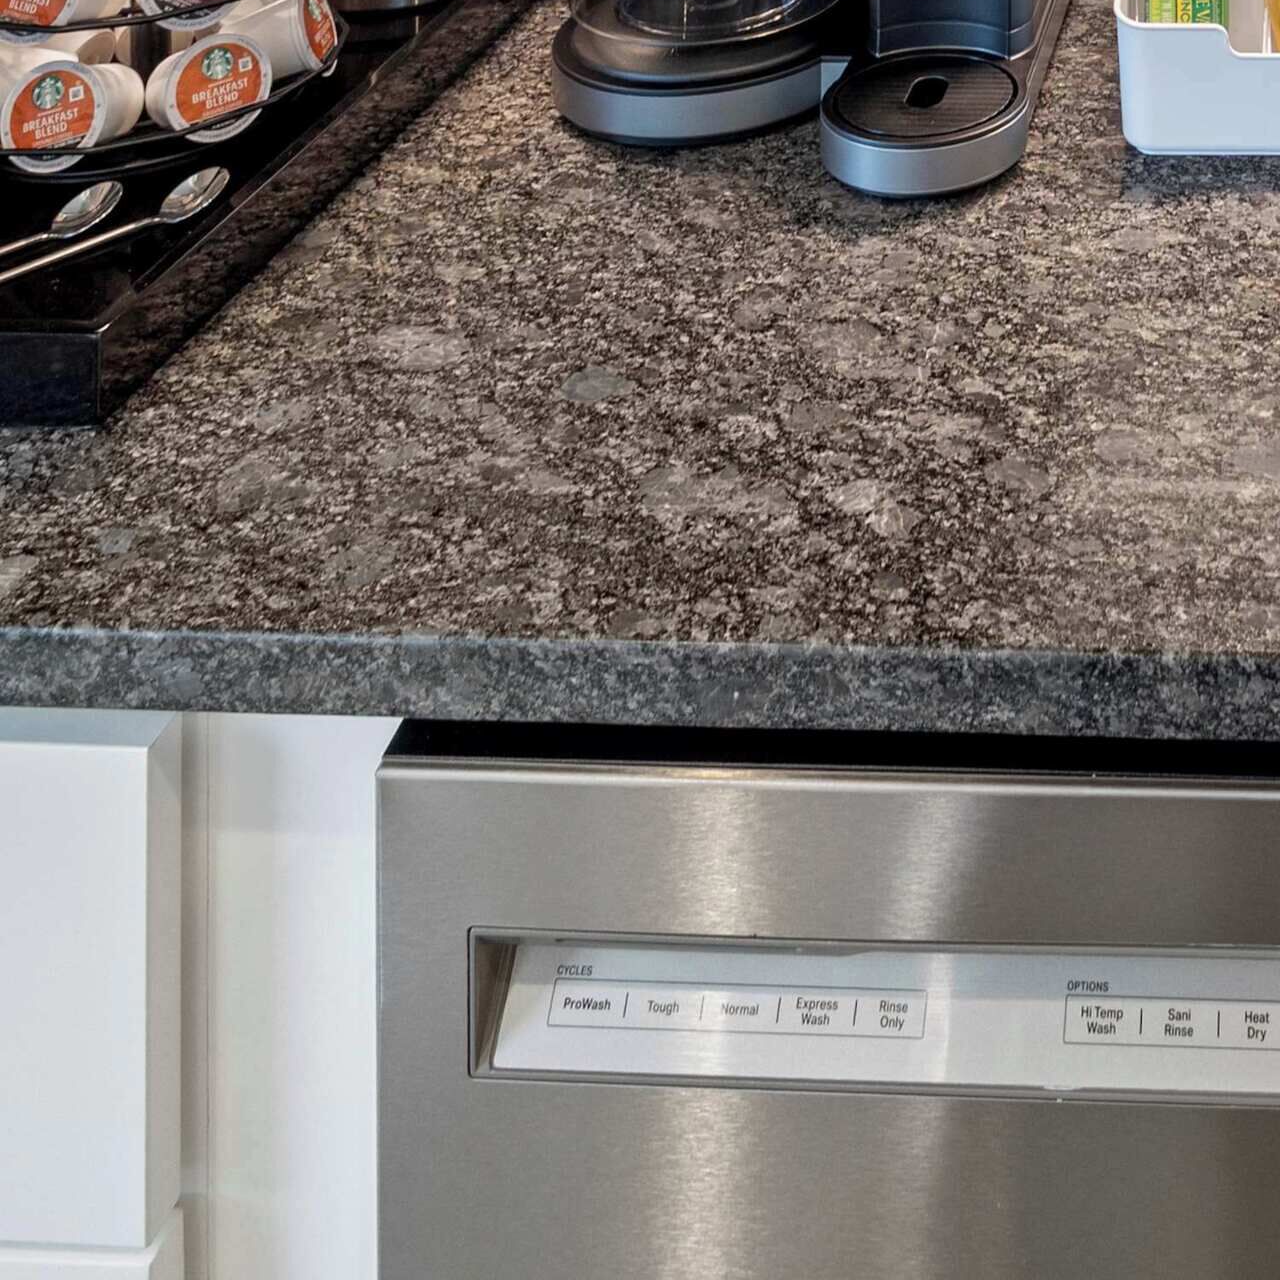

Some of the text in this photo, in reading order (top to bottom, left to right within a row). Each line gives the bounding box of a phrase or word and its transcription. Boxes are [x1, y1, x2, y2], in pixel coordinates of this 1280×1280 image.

[8, 0, 39, 15] BLEND
[192, 77, 249, 105] BREAKFAST
[205, 91, 240, 110] BLEND
[22, 107, 80, 134] BREAKFAST
[35, 122, 69, 140] BLEND
[556, 964, 593, 976] CYCLES
[1066, 980, 1110, 992] OPTIONS
[562, 996, 612, 1011] ProWash
[647, 999, 680, 1016] Tough
[721, 1002, 760, 1017] Normal
[795, 996, 839, 1012] Express
[878, 999, 909, 1014] Rinse
[801, 1013, 831, 1026] Wash
[1080, 1005, 1124, 1021] Hi Temp
[1167, 1007, 1192, 1022] Sani
[1244, 1011, 1270, 1024] Heat
[879, 1016, 905, 1031] Only
[1087, 1022, 1117, 1035] Wash
[1164, 1023, 1194, 1038] Rinse
[1247, 1026, 1268, 1042] Dry
